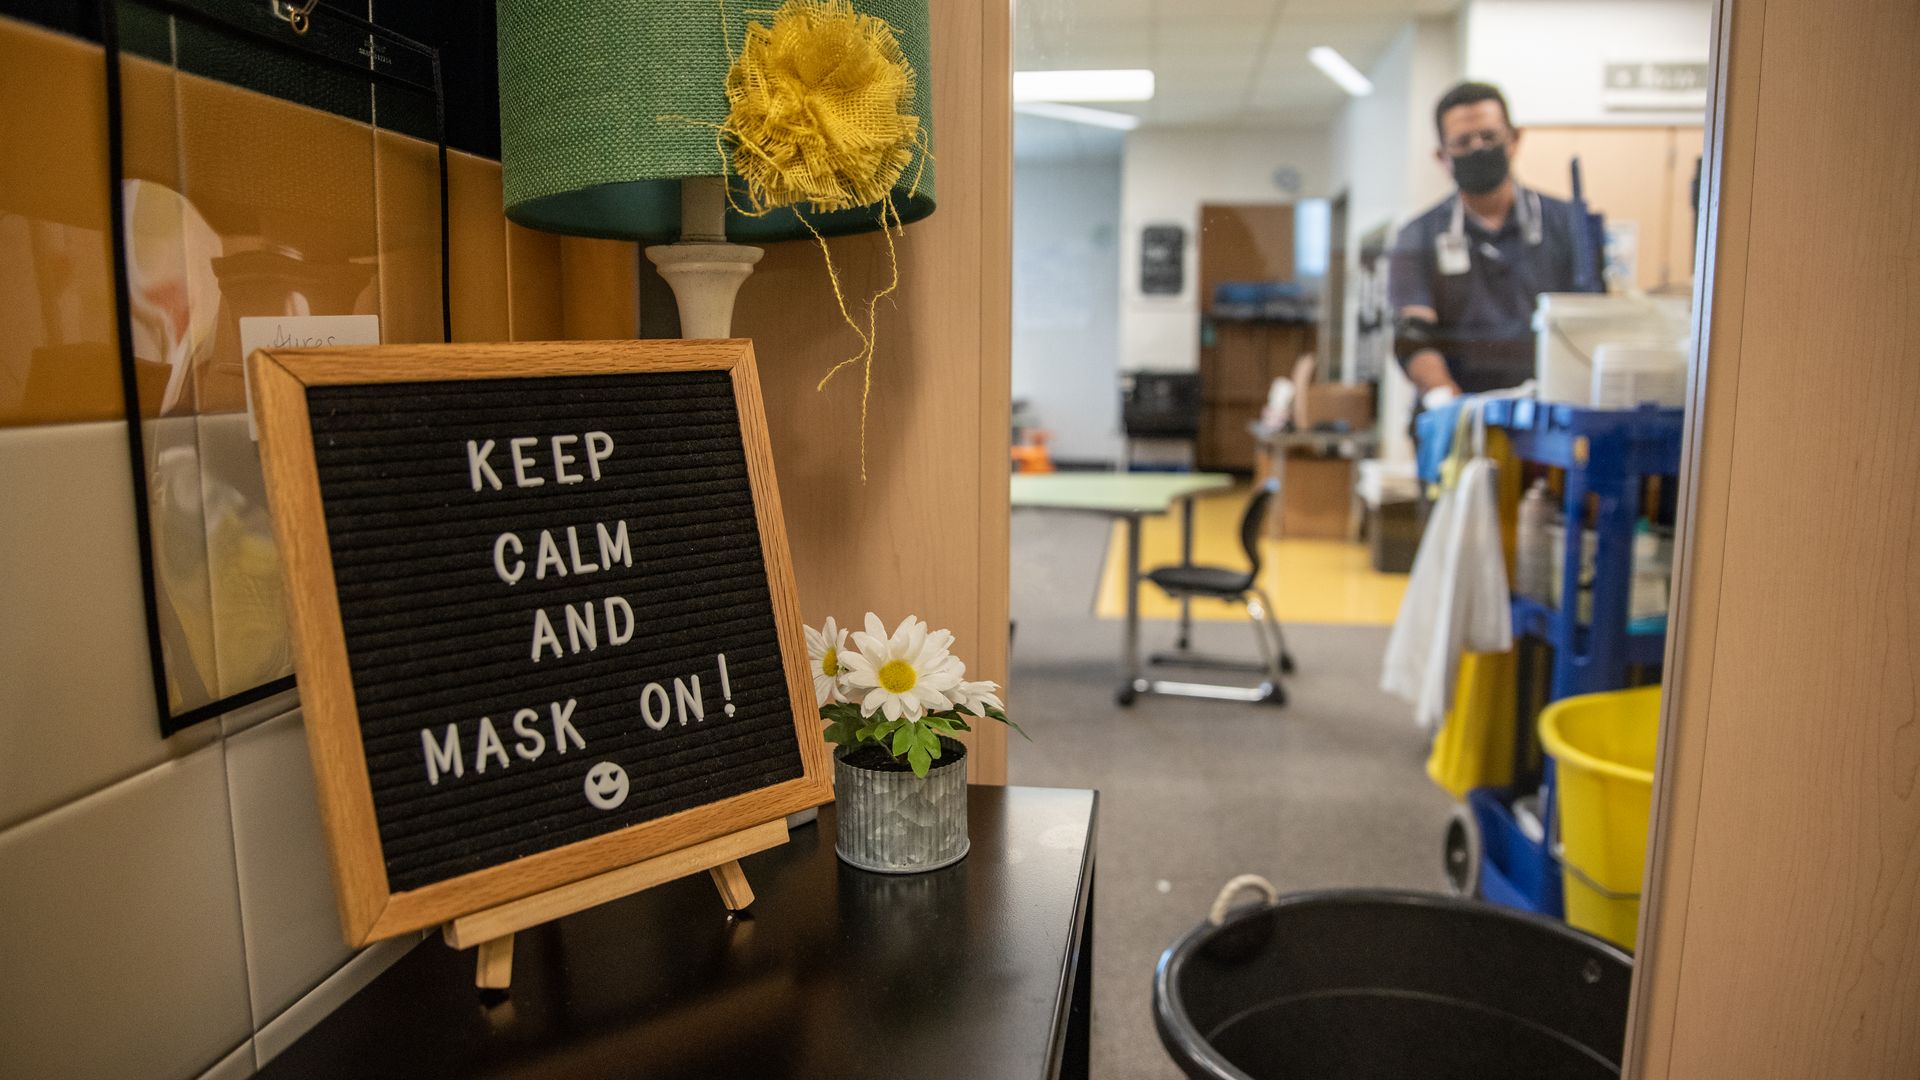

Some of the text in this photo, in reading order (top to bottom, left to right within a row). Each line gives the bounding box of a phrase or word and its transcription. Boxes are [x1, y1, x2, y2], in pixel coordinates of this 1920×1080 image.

[466, 431, 615, 492] KEEP
[493, 519, 633, 586] CALM
[531, 596, 636, 663] AND
[421, 698, 587, 786] MASK
